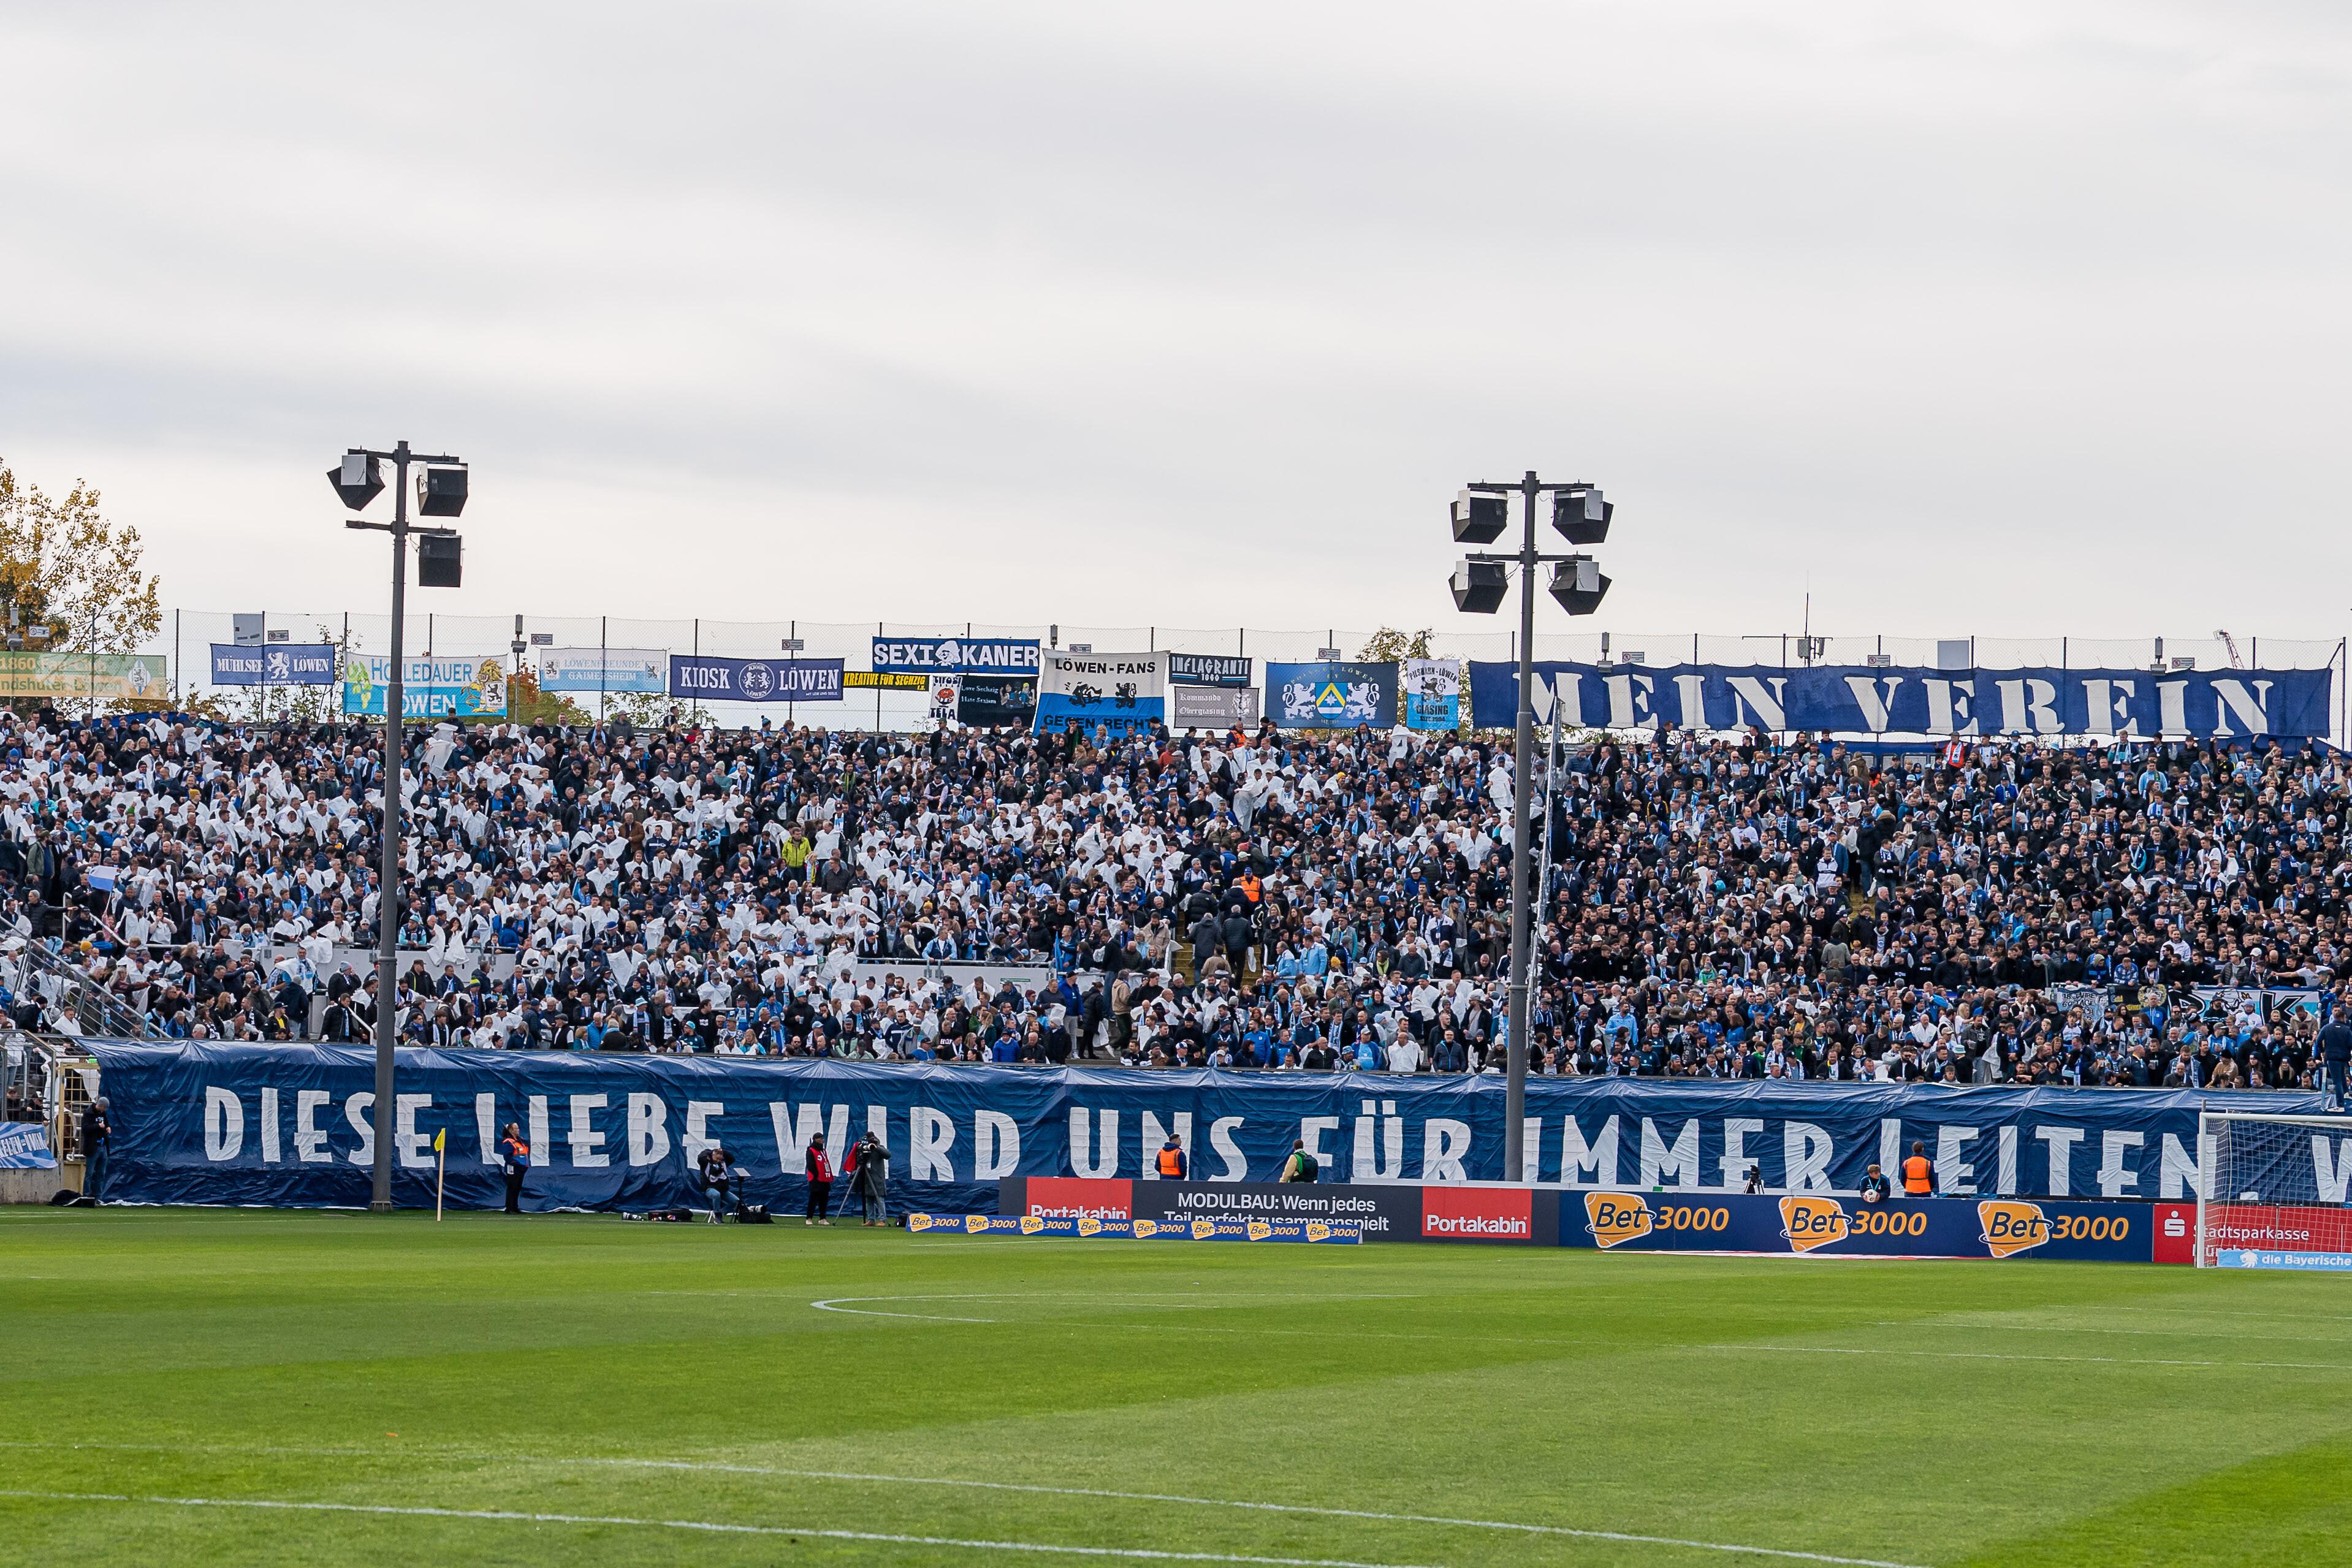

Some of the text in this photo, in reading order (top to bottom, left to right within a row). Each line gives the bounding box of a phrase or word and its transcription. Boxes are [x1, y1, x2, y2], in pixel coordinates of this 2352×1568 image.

[216, 655, 329, 672] MÜHLSEE LÖWEN
[873, 643, 1039, 667] SEXI KANER
[1172, 657, 1248, 675] INFLAGRANTI
[1341, 666, 1375, 683] LÖWEN
[680, 666, 839, 691] KIOSK LÖWEN
[843, 672, 926, 687] KREATIVE FÜR SECHZIG
[1201, 673, 1220, 682] 1860
[976, 685, 999, 694] Sechzig
[1512, 672, 2274, 737] MEIN VEREIN
[205, 1086, 435, 1168] DIESE
[476, 1092, 724, 1170] LIEBE
[769, 1102, 1020, 1182] WIRD
[1070, 1106, 1247, 1182] UNS
[1300, 1100, 1471, 1182] FÜR
[1523, 1114, 1833, 1190] IMMER
[1030, 1205, 1127, 1220] Portakabin
[1178, 1193, 1376, 1214] MODULBAU: Wenn jedes
[1426, 1214, 1526, 1234] Portakabin
[1655, 1206, 1729, 1231] 3000
[1850, 1210, 1927, 1236] 3000
[2052, 1215, 2129, 1241] 3000
[2262, 1254, 2351, 1266] die Bayerische
